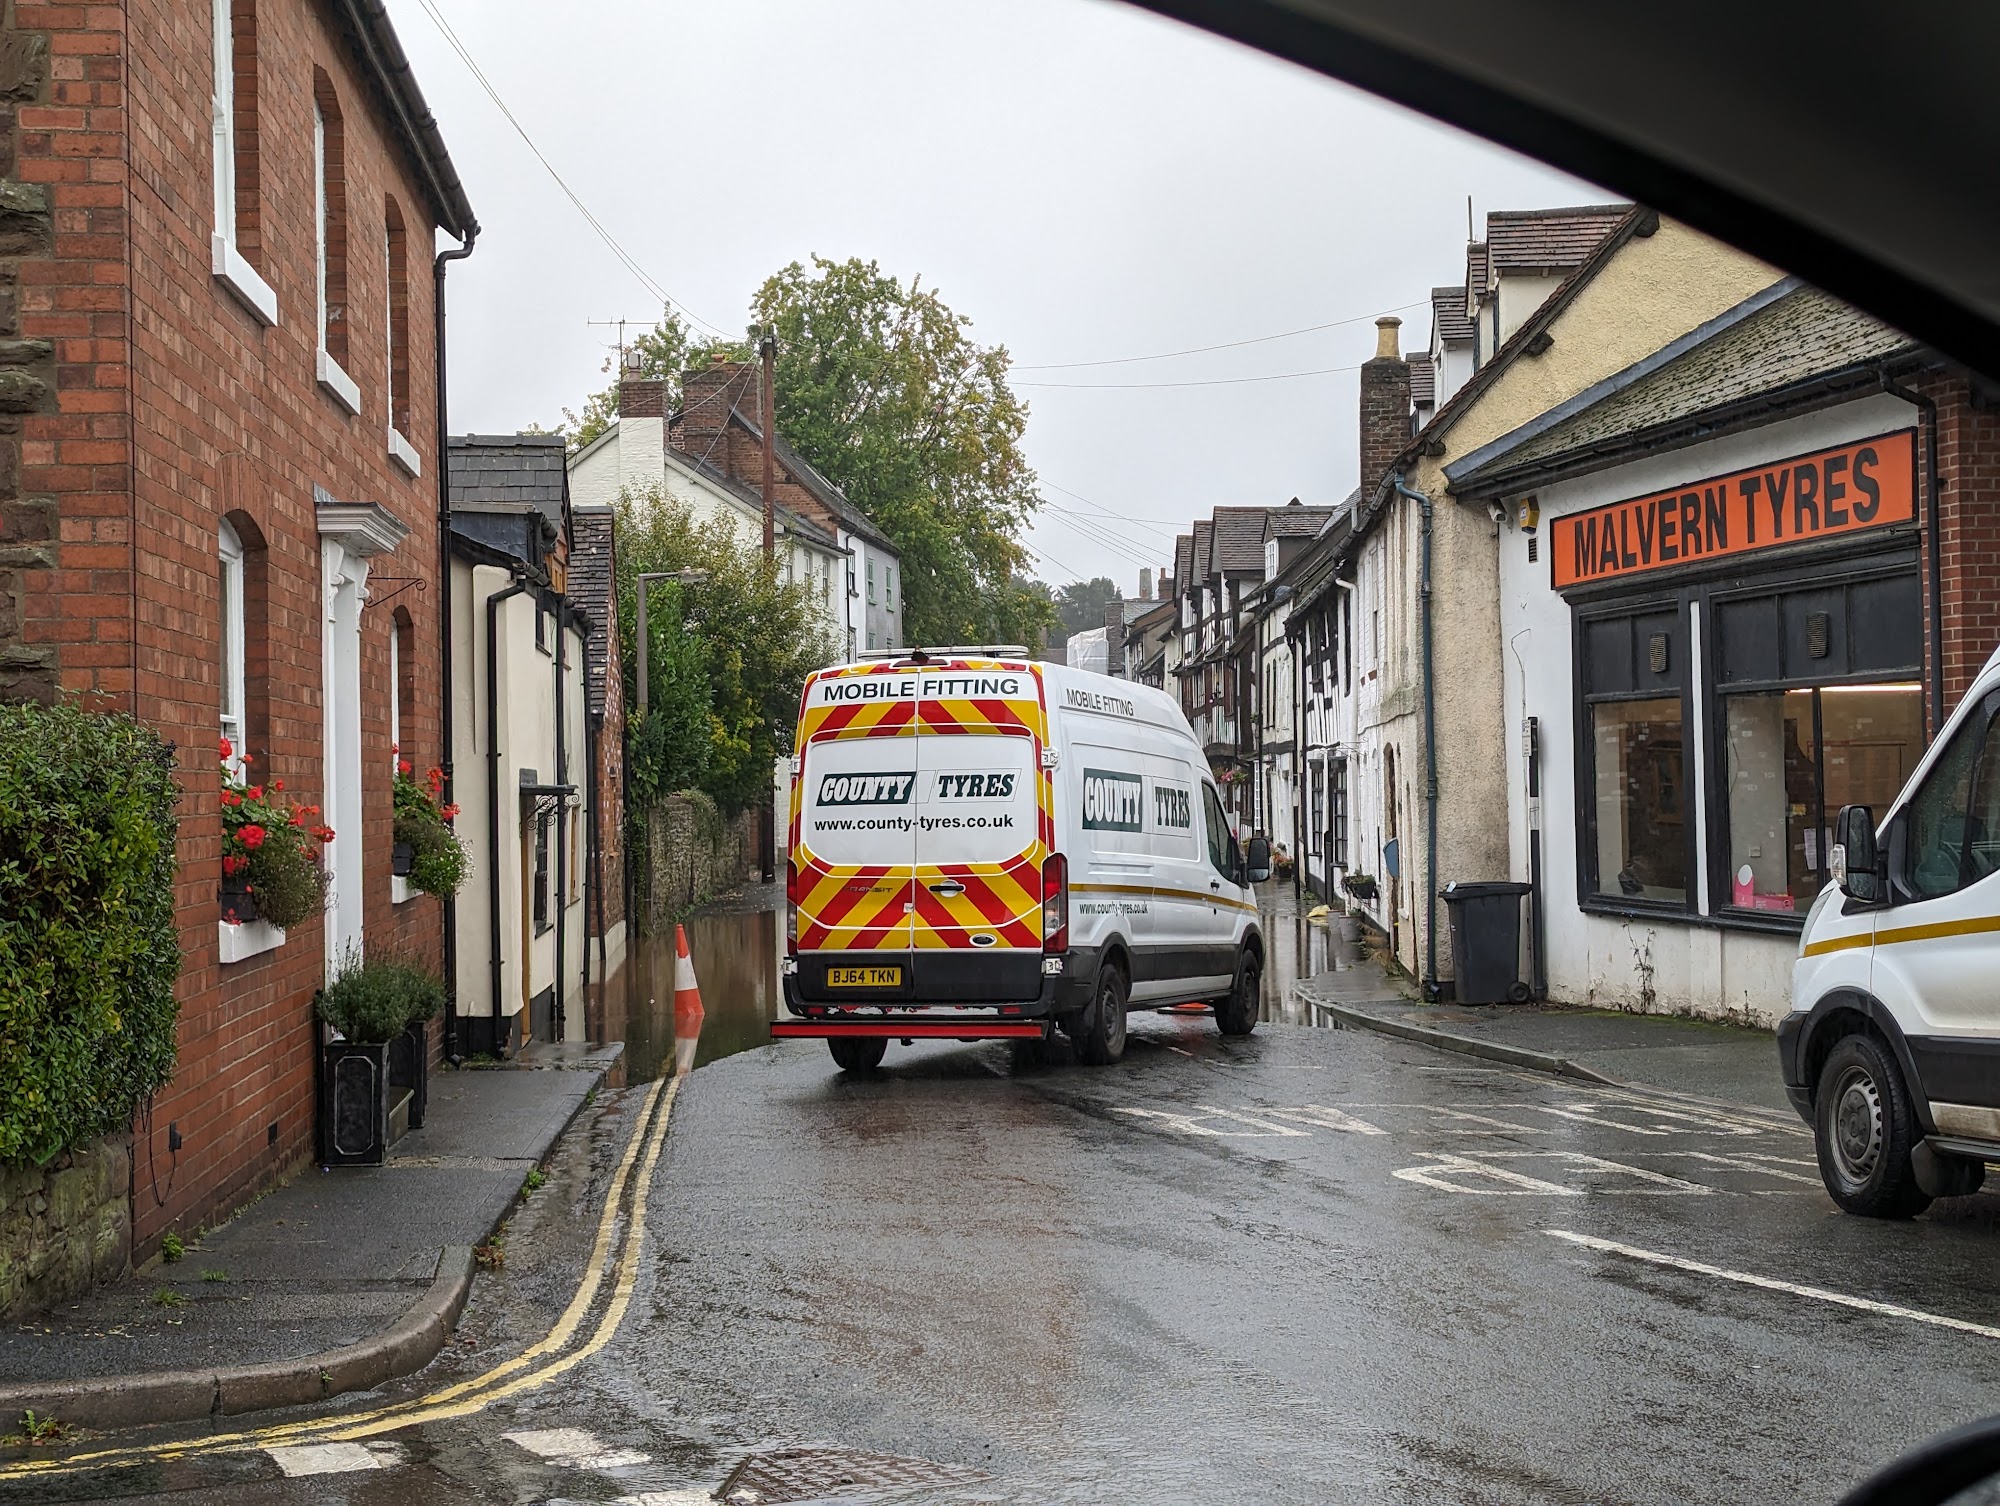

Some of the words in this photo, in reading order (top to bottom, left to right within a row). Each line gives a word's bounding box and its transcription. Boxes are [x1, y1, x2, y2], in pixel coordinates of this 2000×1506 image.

[1574, 484, 1728, 578] MALVERN
[1739, 447, 1881, 544] TYRES
[824, 681, 915, 701] MOBILE
[923, 678, 1019, 696] FITTING
[1066, 688, 1101, 710] MOBILE
[1103, 695, 1134, 716] FITTING
[820, 774, 913, 802] COUNTY
[938, 773, 1015, 798] TYRES
[1084, 776, 1141, 824] COUNTY
[1155, 786, 1190, 829] TYRES
[814, 814, 1014, 832] www.county-tyres.co.uk
[1079, 900, 1148, 917] www.county-tyres.co.uk
[833, 970, 865, 984] BJ64
[870, 969, 896, 983] TKN
